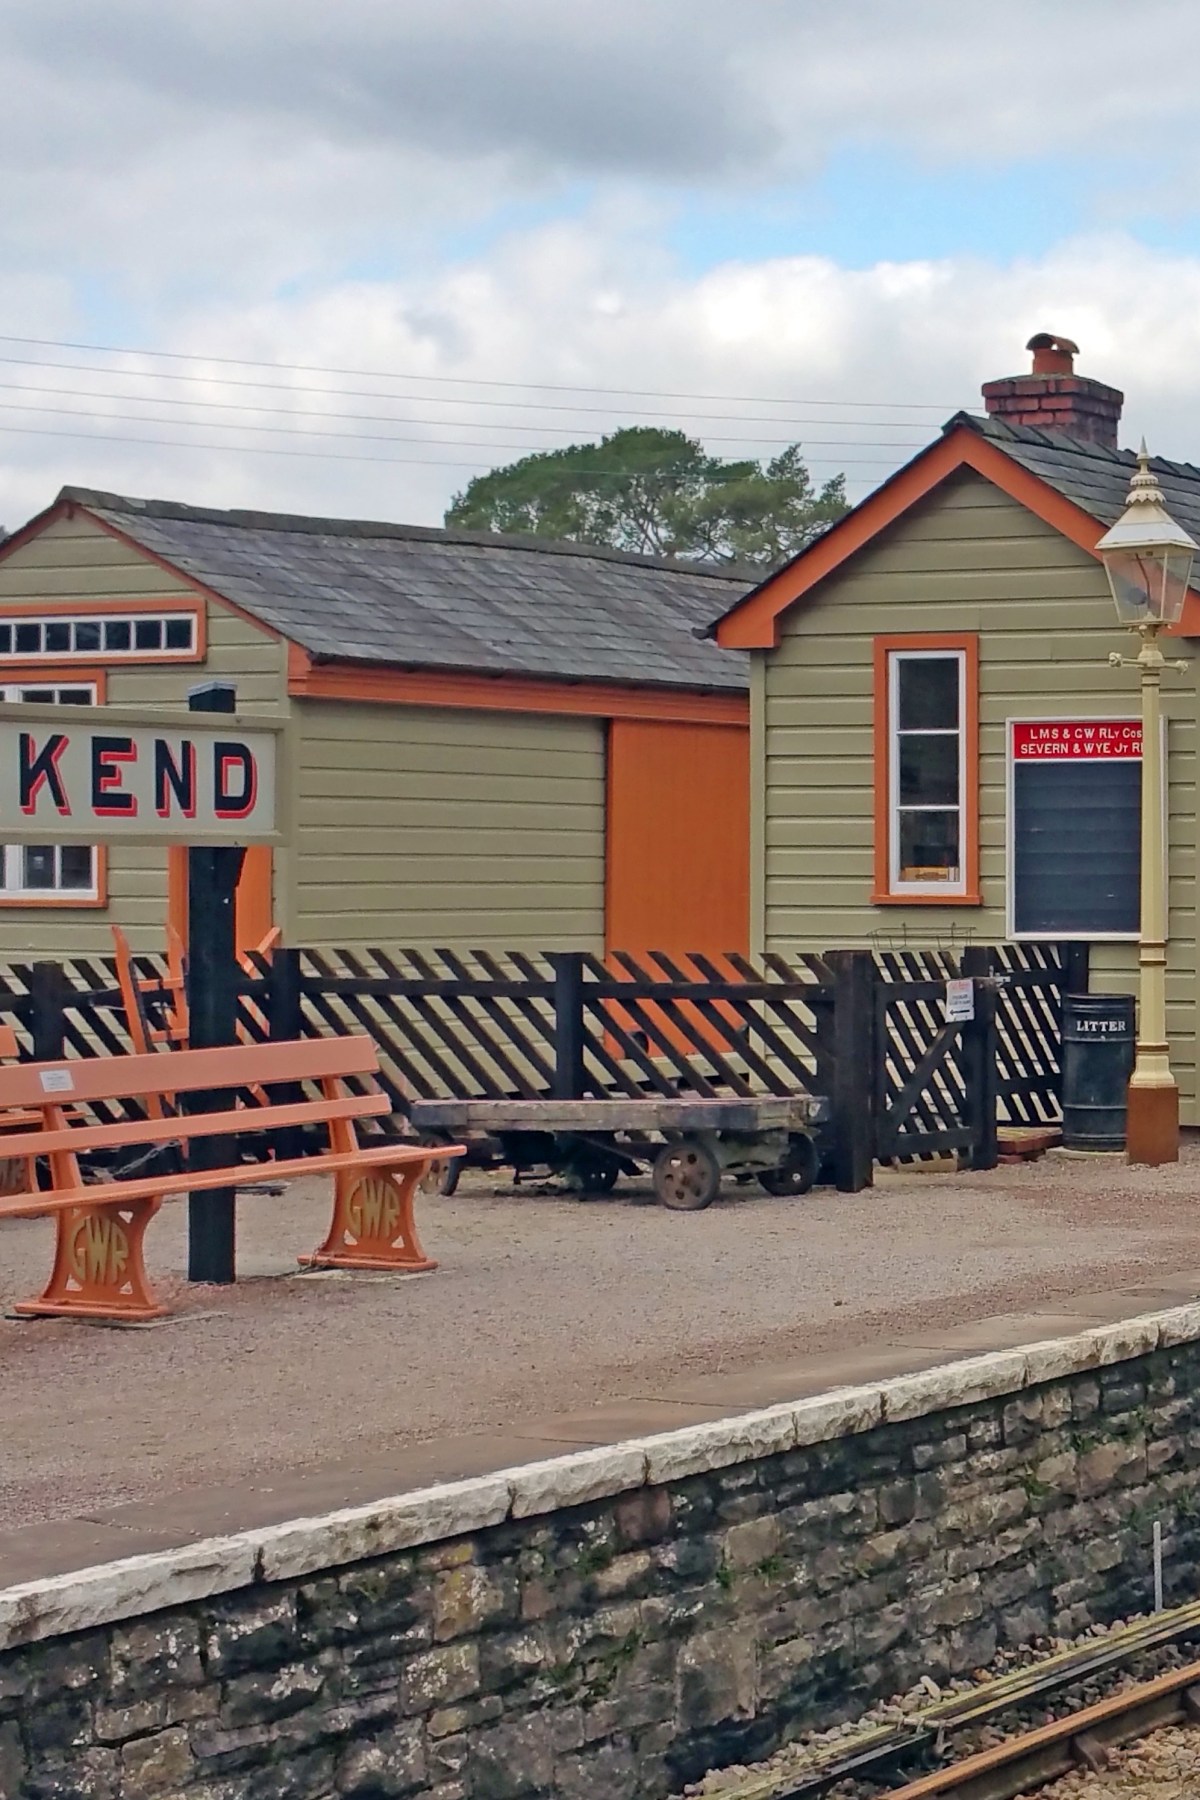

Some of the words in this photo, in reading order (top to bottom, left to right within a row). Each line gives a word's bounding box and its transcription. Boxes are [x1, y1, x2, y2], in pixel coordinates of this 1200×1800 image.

[1020, 743, 1068, 754] SEVERN
[1072, 743, 1080, 753] &
[1083, 743, 1111, 753] WYE
[1030, 728, 1059, 739] LMS
[1063, 729, 1070, 739] &
[20, 733, 257, 819] KEND
[1076, 1020, 1126, 1032] LITTER
[344, 1176, 400, 1238] GWR
[68, 1213, 129, 1285] GWR
